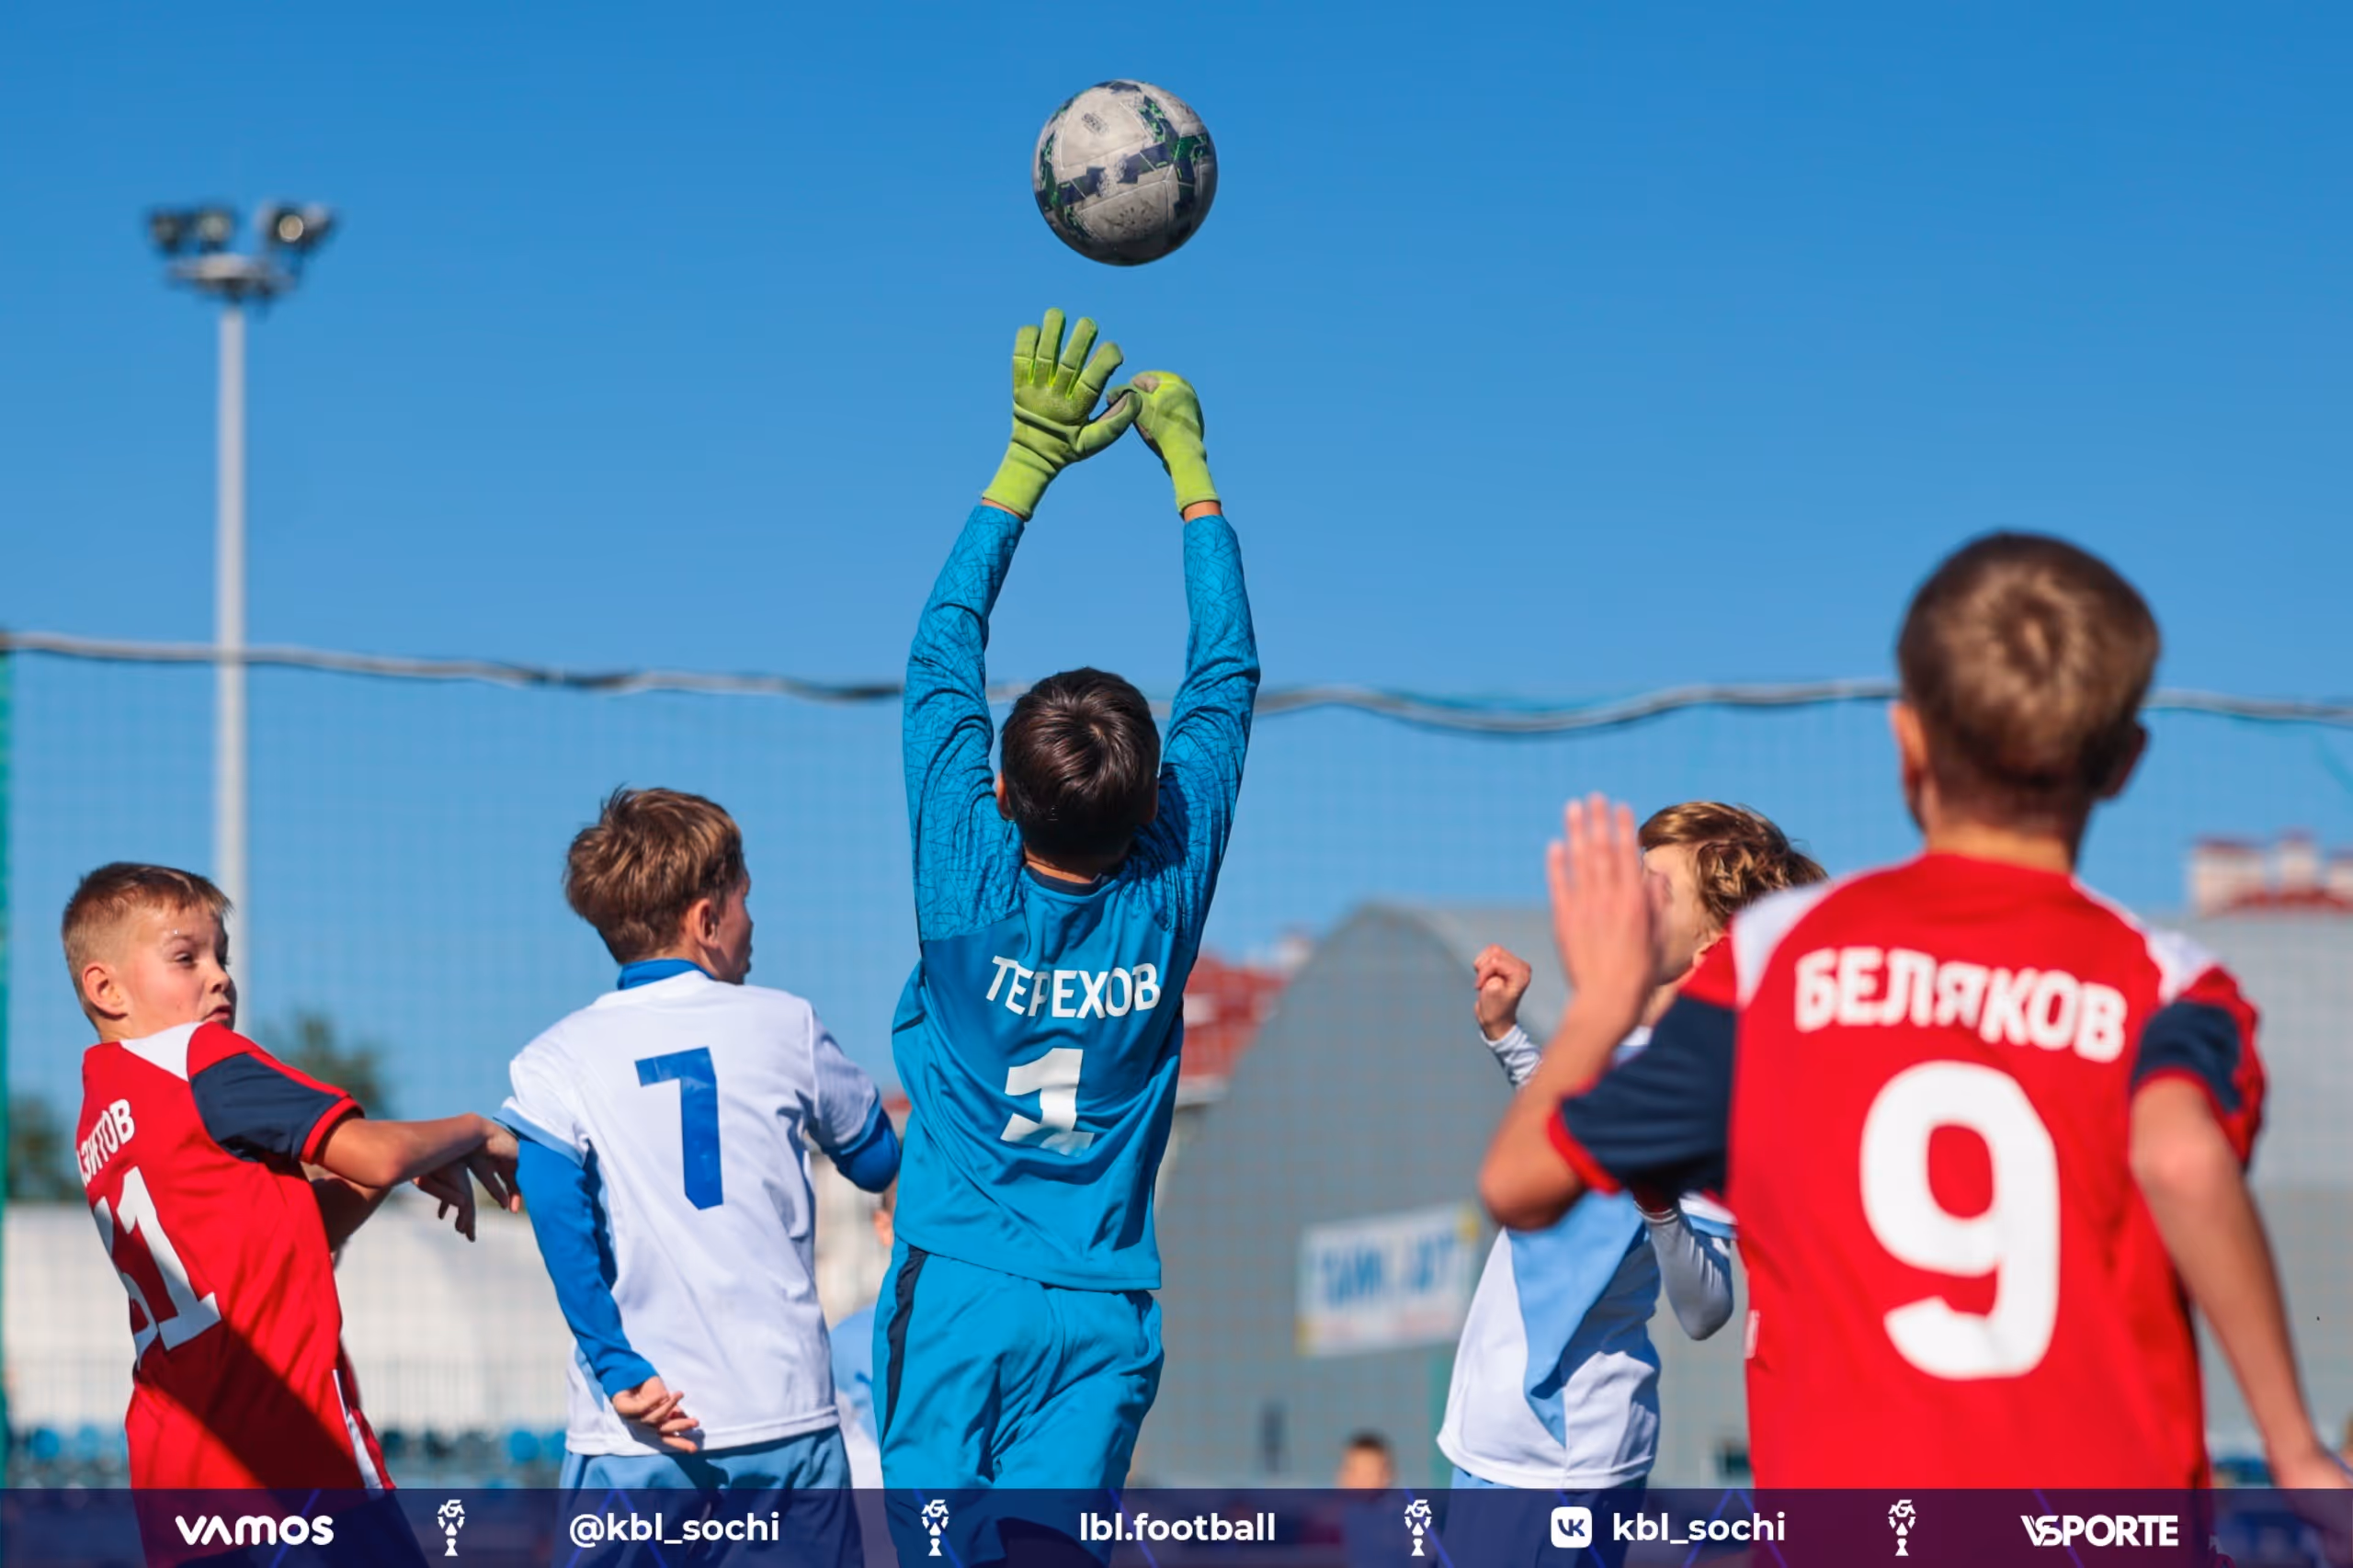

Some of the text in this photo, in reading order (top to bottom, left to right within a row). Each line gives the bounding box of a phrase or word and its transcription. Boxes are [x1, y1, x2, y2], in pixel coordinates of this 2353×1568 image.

[985, 955, 1162, 1019] ТЕРЕХОВ
[1794, 946, 2128, 1063] БЕЛЯКОВ
[634, 1046, 724, 1210] 7
[1000, 1047, 1096, 1157] 1
[1859, 1060, 2061, 1381] 9
